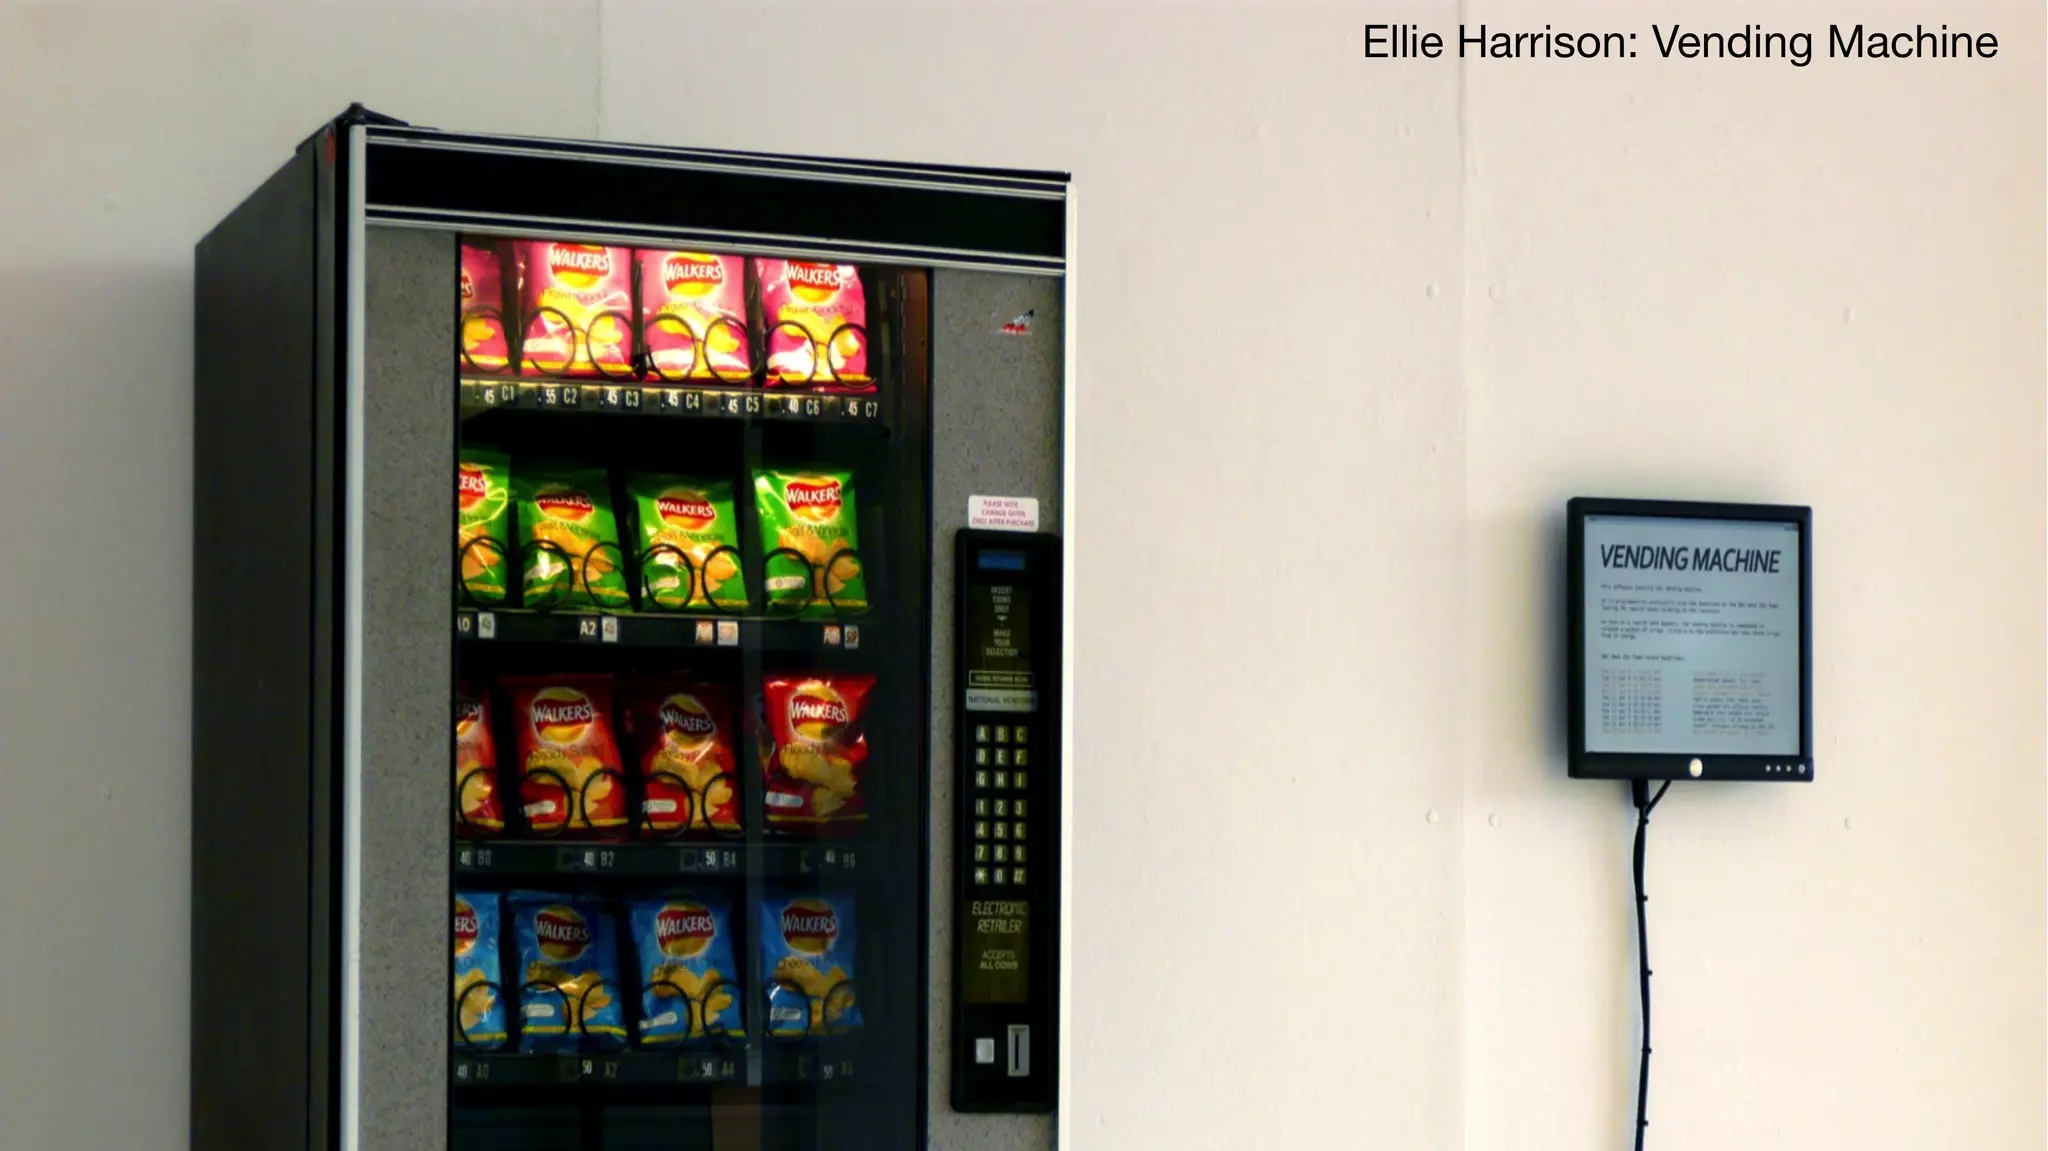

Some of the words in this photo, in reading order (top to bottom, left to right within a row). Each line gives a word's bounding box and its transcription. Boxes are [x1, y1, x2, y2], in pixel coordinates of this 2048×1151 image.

[550, 248, 609, 270] WALKERS
[665, 263, 724, 281] WALKERS
[786, 264, 842, 287] WALKERS
[501, 386, 515, 401] C1
[563, 388, 577, 404] C2
[625, 391, 639, 407] C3
[686, 393, 700, 409] C4
[745, 396, 759, 412] C5
[806, 399, 820, 415] C6
[865, 402, 879, 418] C7
[786, 487, 841, 504] WALKERS
[657, 500, 714, 518] WALKERS
[1601, 544, 1688, 570] VENDING
[1692, 548, 1781, 573] MACHINE
[580, 620, 596, 635] A2
[532, 704, 592, 724] WALKERS
[660, 707, 712, 731] WALKERS
[792, 701, 846, 722] WALKERS
[601, 850, 615, 867] B2
[536, 919, 588, 941] WALKERS
[656, 916, 713, 936] WALKERS
[783, 914, 836, 934] WALKERS
